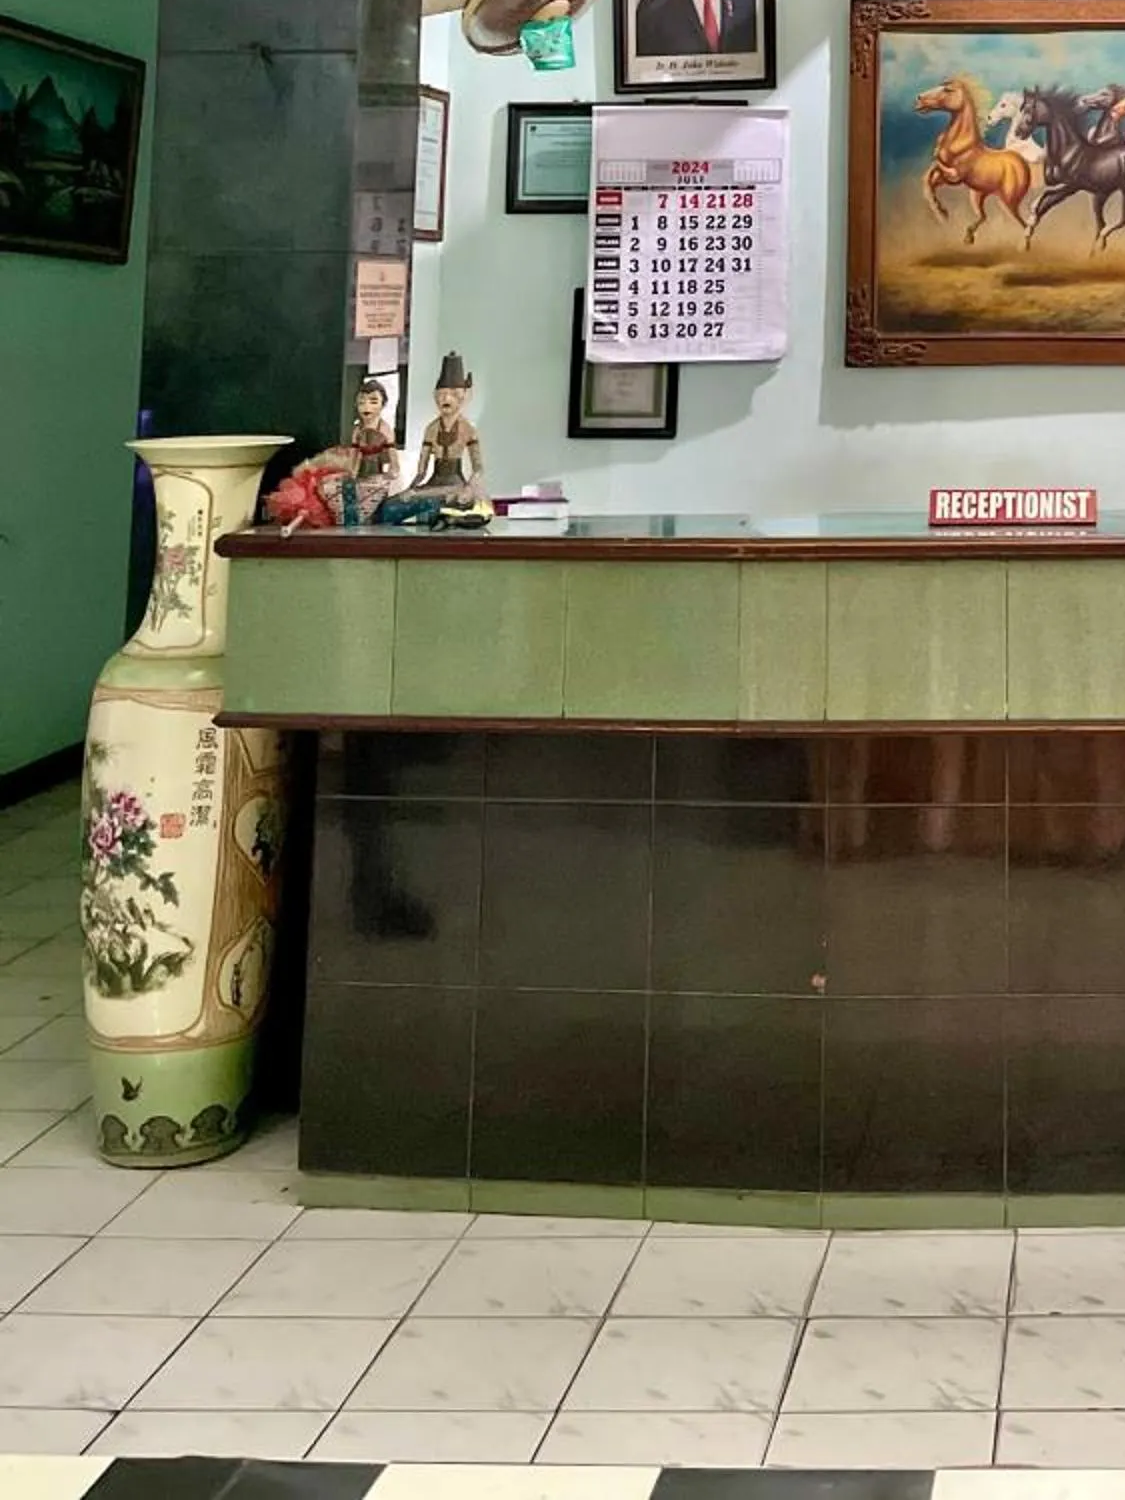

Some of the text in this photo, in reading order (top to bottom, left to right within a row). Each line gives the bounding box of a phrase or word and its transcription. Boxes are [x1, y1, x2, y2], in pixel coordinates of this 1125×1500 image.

[671, 160, 709, 174] 2024
[657, 192, 754, 210] 7 14 21 28
[631, 215, 639, 231] 1
[657, 215, 668, 231] 8
[679, 215, 699, 231] 15
[705, 214, 727, 231] 22
[731, 213, 753, 230] 29
[629, 237, 641, 253] 2
[656, 236, 667, 252] 9
[679, 236, 699, 252] 16
[705, 235, 727, 251] 23
[731, 235, 753, 251] 30
[629, 258, 640, 274] 3
[651, 258, 672, 273] 10
[678, 257, 699, 273] 17
[704, 257, 726, 273] 24
[731, 257, 752, 273] 31
[628, 279, 639, 296] 4
[651, 279, 671, 295] 11
[677, 279, 698, 295] 18
[703, 279, 725, 295] 25
[628, 301, 639, 317] 5
[650, 301, 671, 317] 12
[677, 301, 698, 317] 19
[703, 300, 725, 317] 26
[627, 323, 639, 339] 6
[649, 323, 670, 339] 13
[675, 322, 698, 339] 20
[703, 321, 725, 338] 27
[935, 491, 1091, 519] RECEPTIONIST
